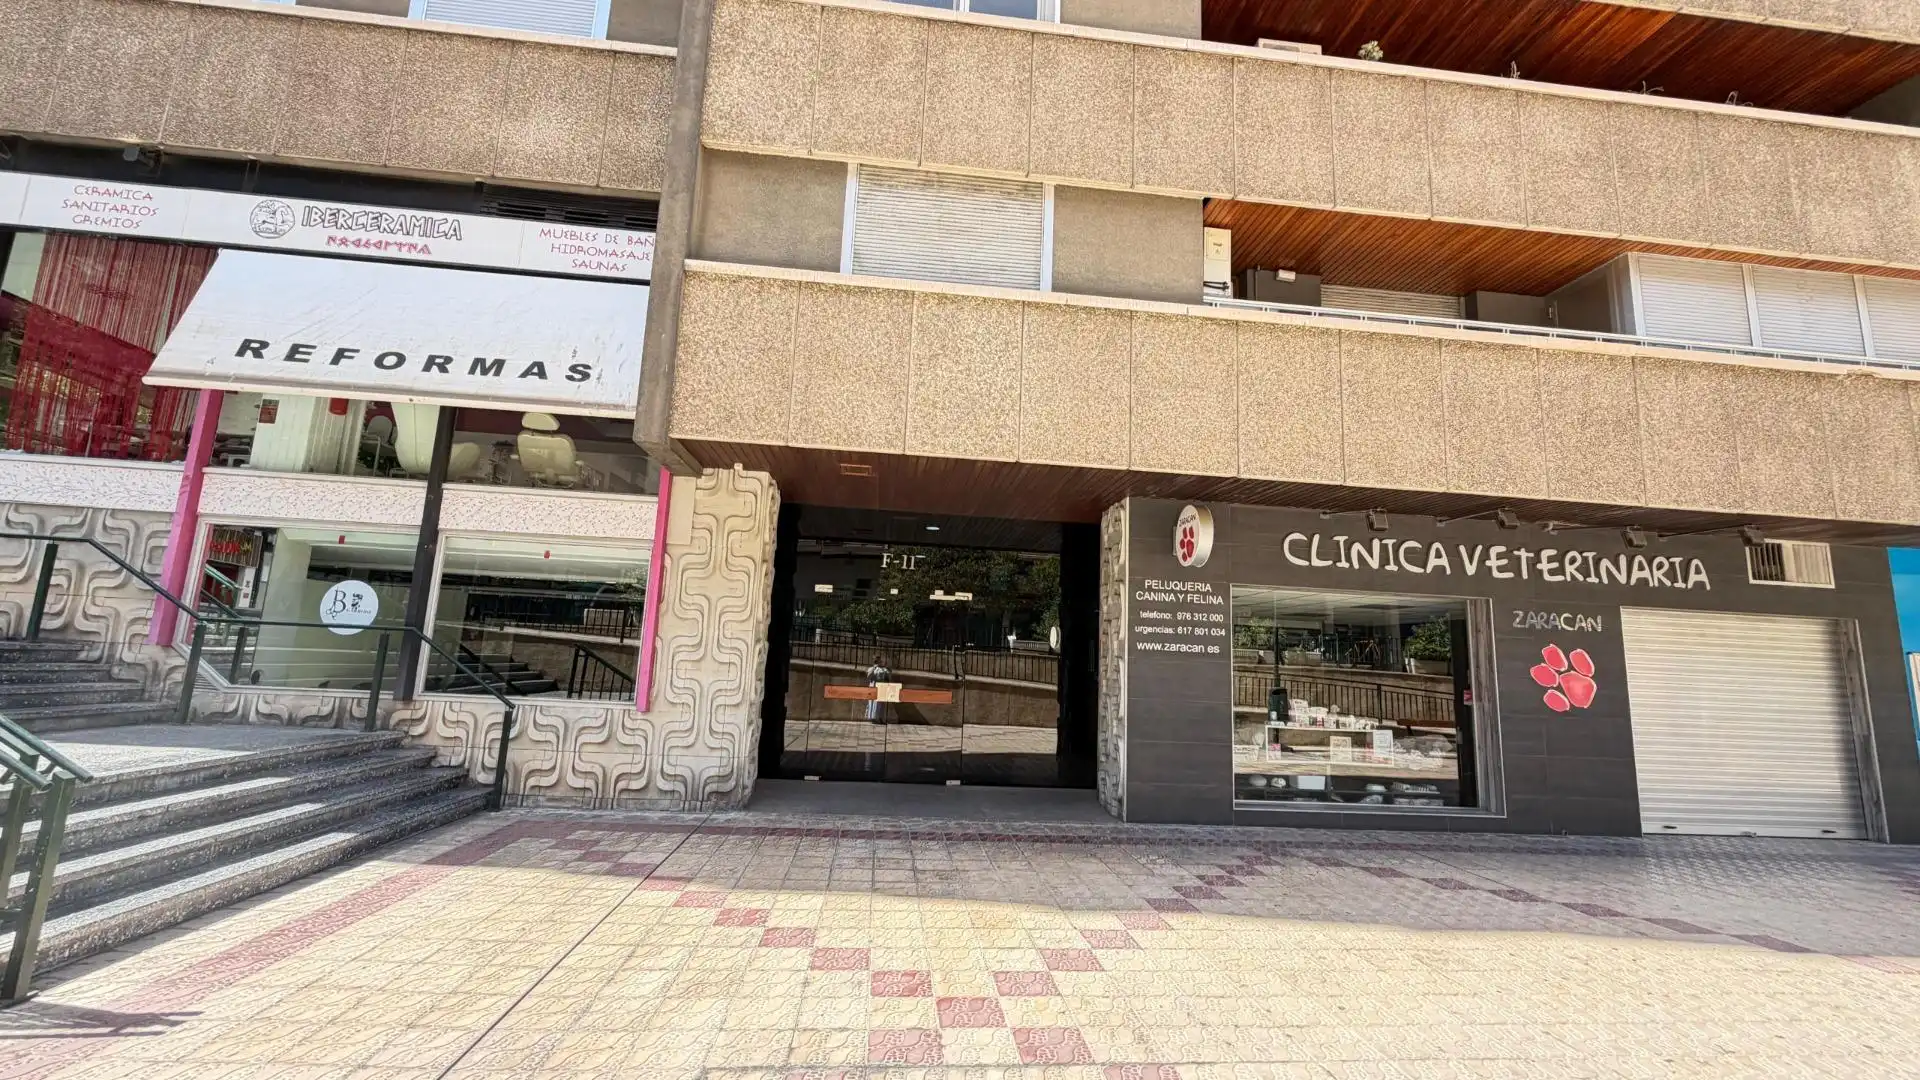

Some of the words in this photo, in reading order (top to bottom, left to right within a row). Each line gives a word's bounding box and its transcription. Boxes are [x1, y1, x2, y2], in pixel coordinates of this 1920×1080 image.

[73, 184, 153, 201] CERAMICA
[61, 199, 160, 217] SANITARIOS
[301, 205, 463, 241] IBERCERAMICA
[539, 227, 599, 243] MUEBLES
[604, 232, 619, 245] DE
[627, 234, 656, 248] BAÑ
[550, 242, 651, 262] HIDROMASAJE
[571, 258, 628, 273] SAUNAS
[234, 337, 593, 383] REFORMAS
[1282, 532, 1452, 576] CLINICA
[1458, 543, 1711, 592] VETERINARIA
[1144, 579, 1212, 592] PELUQUERIA
[1135, 590, 1177, 602] CANINA
[1177, 593, 1185, 603] Y
[1187, 593, 1224, 605] FELINA
[1176, 611, 1191, 621] 976
[1193, 612, 1208, 622] 312
[1209, 613, 1224, 622] 000
[1512, 610, 1602, 632] ZARACAN
[1210, 628, 1226, 637] 034
